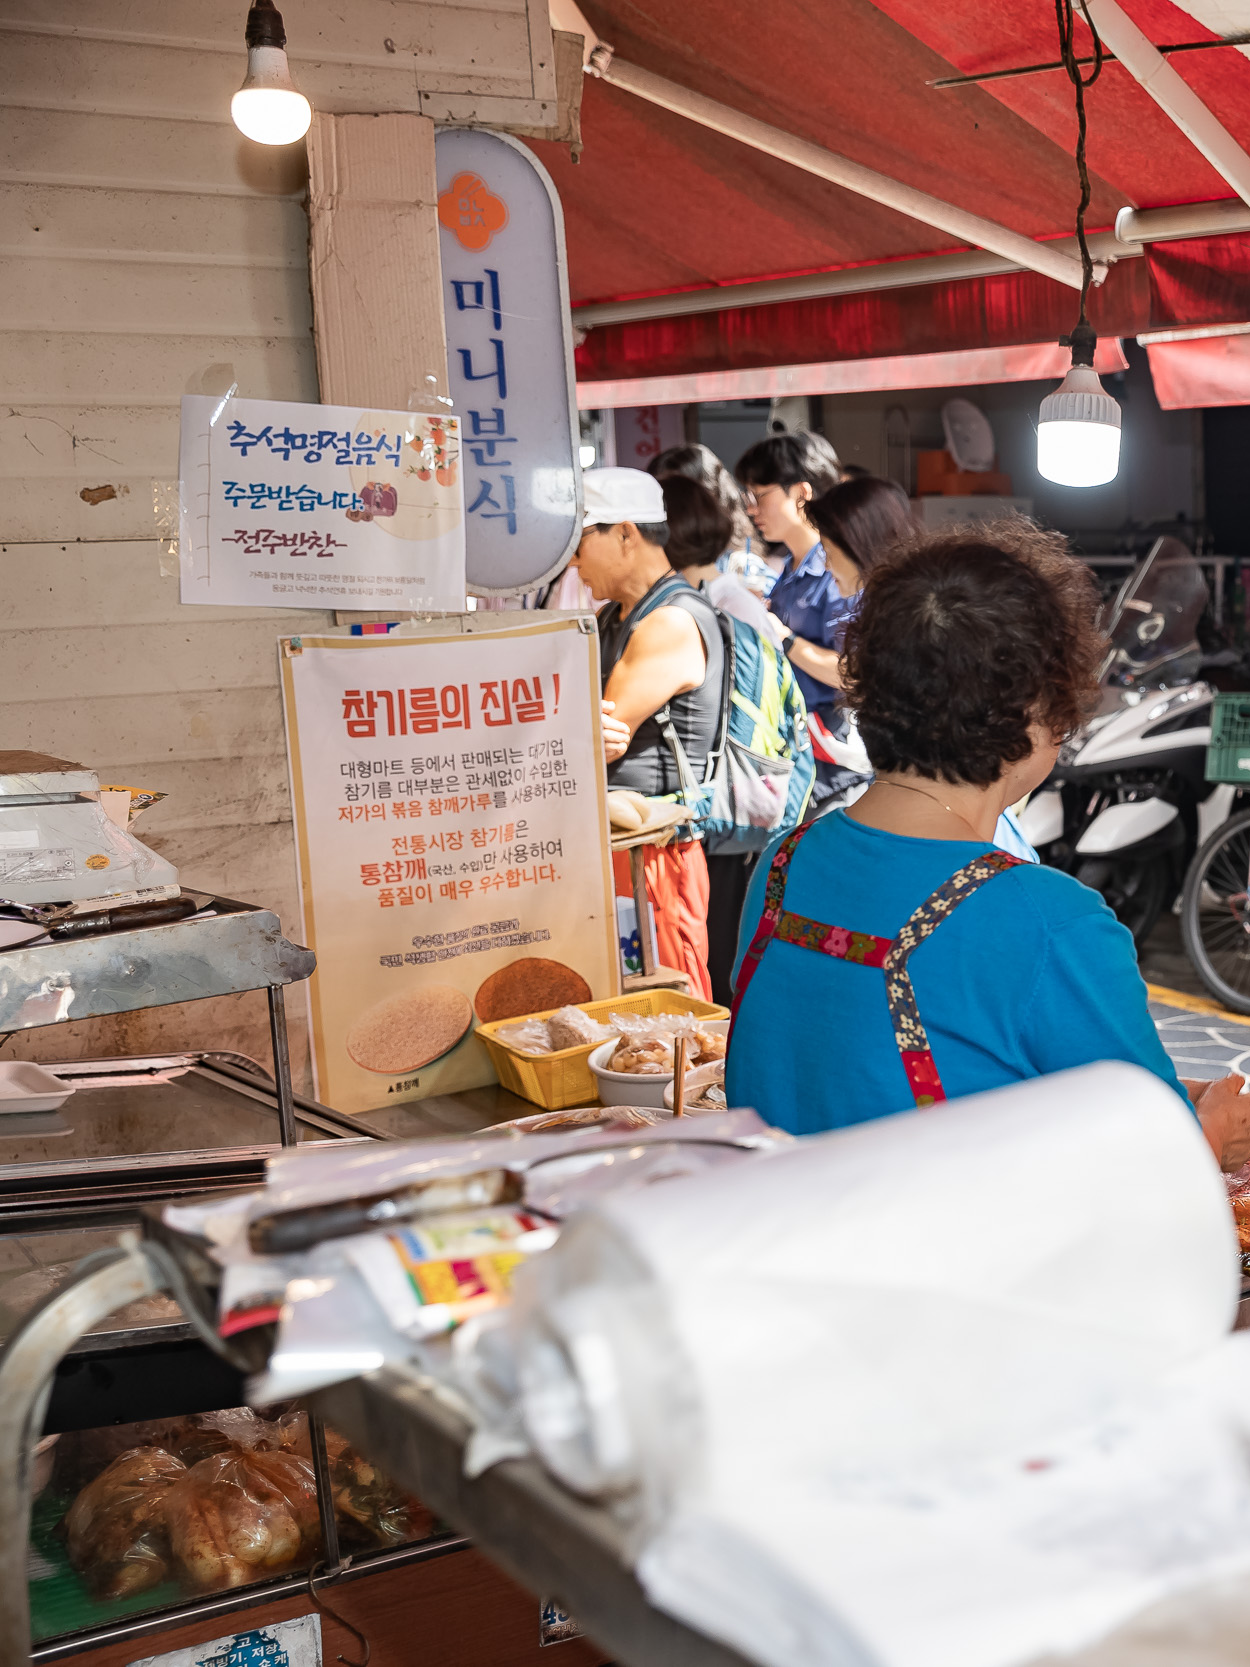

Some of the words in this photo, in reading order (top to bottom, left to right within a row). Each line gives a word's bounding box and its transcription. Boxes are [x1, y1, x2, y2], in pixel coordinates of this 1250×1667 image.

[450, 269, 517, 535] 미니분식
[226, 420, 402, 467] 추석명절음식
[222, 481, 365, 512] 주문받습니다.
[341, 683, 473, 738] 참기름의
[340, 759, 406, 779] 대형마트
[411, 754, 456, 775] 등에서
[461, 748, 524, 770] 판매되는
[528, 738, 564, 760] 대기업
[344, 781, 393, 802] 참기름
[398, 775, 461, 797] 대부분은
[466, 767, 526, 790] 관세없이
[529, 759, 569, 779] 수입한
[338, 803, 387, 823] 저가의
[391, 800, 423, 820] 볶음
[428, 791, 508, 816] 참깨가루를
[511, 778, 579, 804] 사용하지만
[391, 830, 464, 857] 전통시장
[470, 819, 530, 848] 참기름은
[499, 838, 564, 865] 사용하여
[377, 883, 434, 909] 품질이
[439, 879, 475, 901] 매우
[479, 862, 562, 894] 우수합니다.
